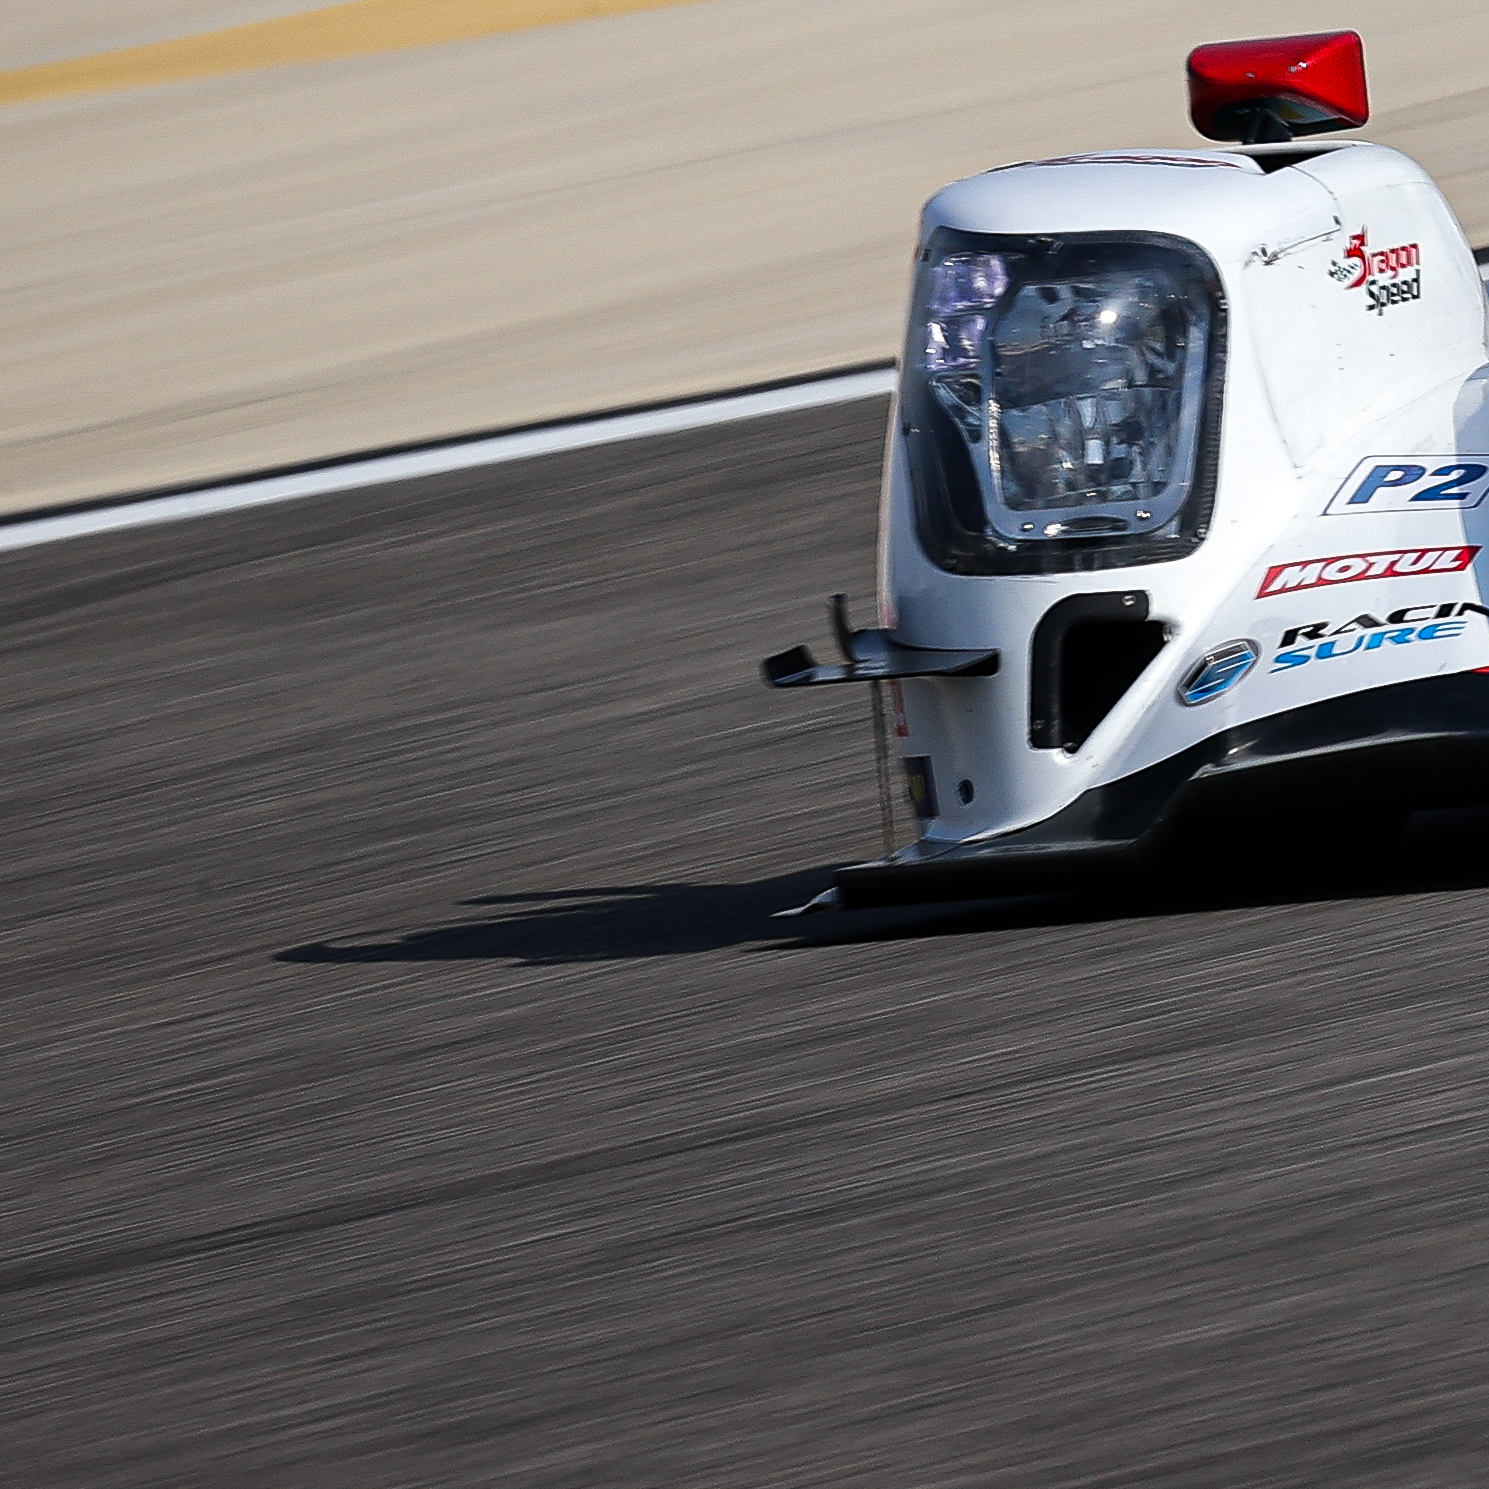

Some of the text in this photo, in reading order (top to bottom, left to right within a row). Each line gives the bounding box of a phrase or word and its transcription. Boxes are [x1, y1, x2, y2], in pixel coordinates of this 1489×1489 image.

[1366, 269, 1421, 317] Speed
[1264, 549, 1465, 594] MOTUL
[1268, 620, 1468, 675] SURE
